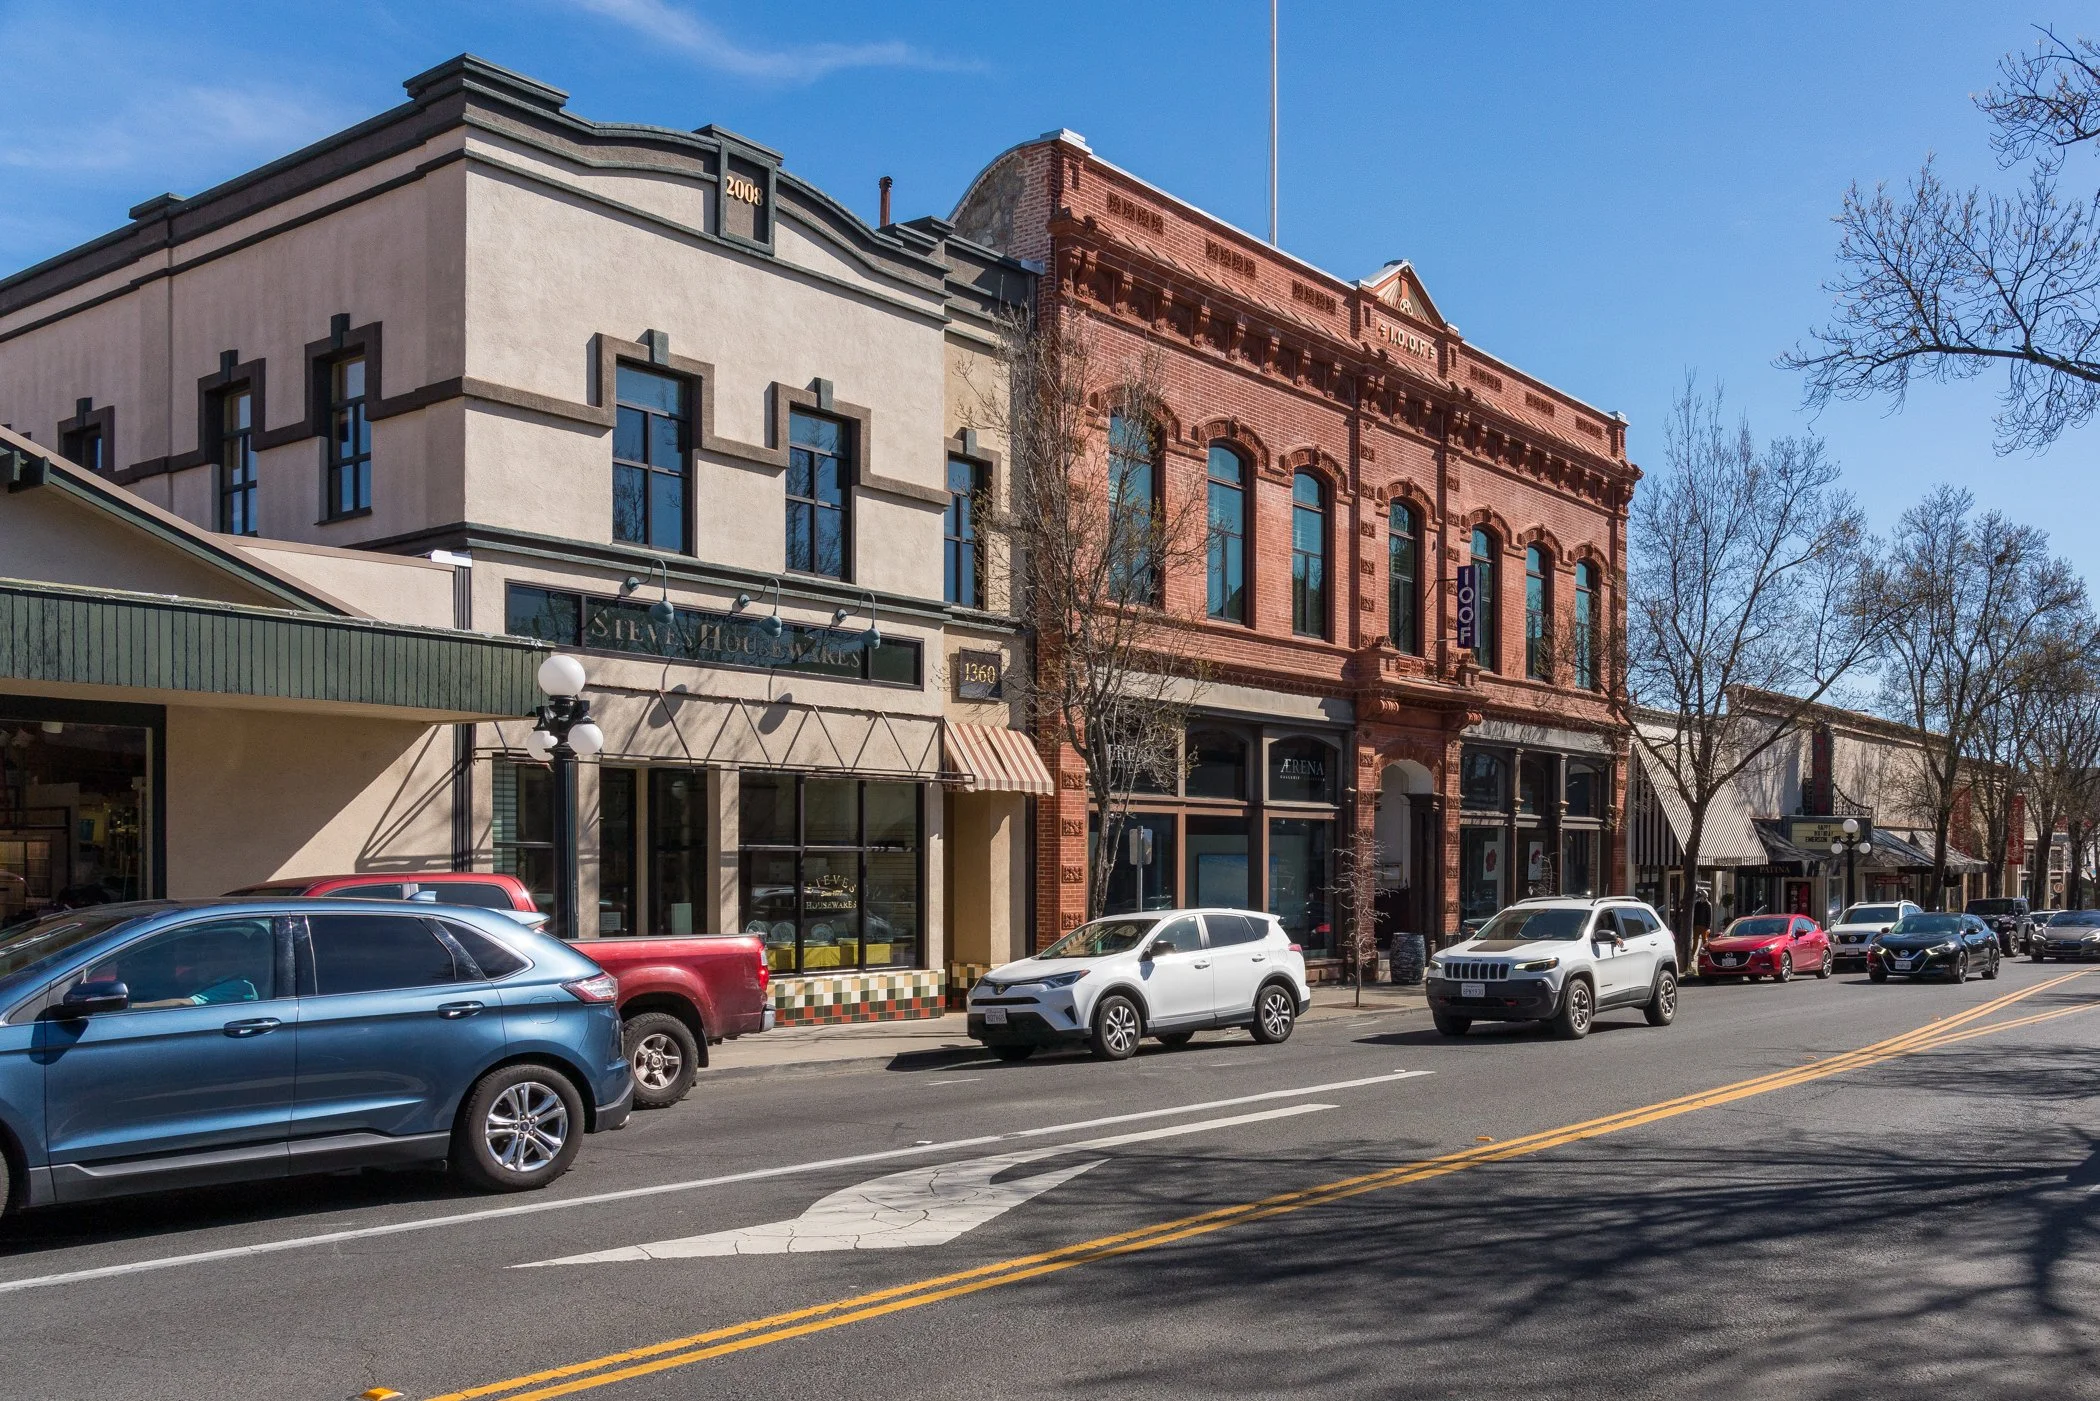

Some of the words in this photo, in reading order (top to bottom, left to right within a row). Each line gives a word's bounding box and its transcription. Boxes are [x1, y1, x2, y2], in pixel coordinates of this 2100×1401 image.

[726, 175, 763, 206] 2008
[1458, 568, 1474, 645] IOOF
[965, 663, 995, 684] 1360
[1280, 758, 1324, 776] ÆRENA
[1760, 866, 1790, 874] PATINA
[806, 875, 857, 893] STEVES
[805, 900, 857, 910] HOUSEWARES
